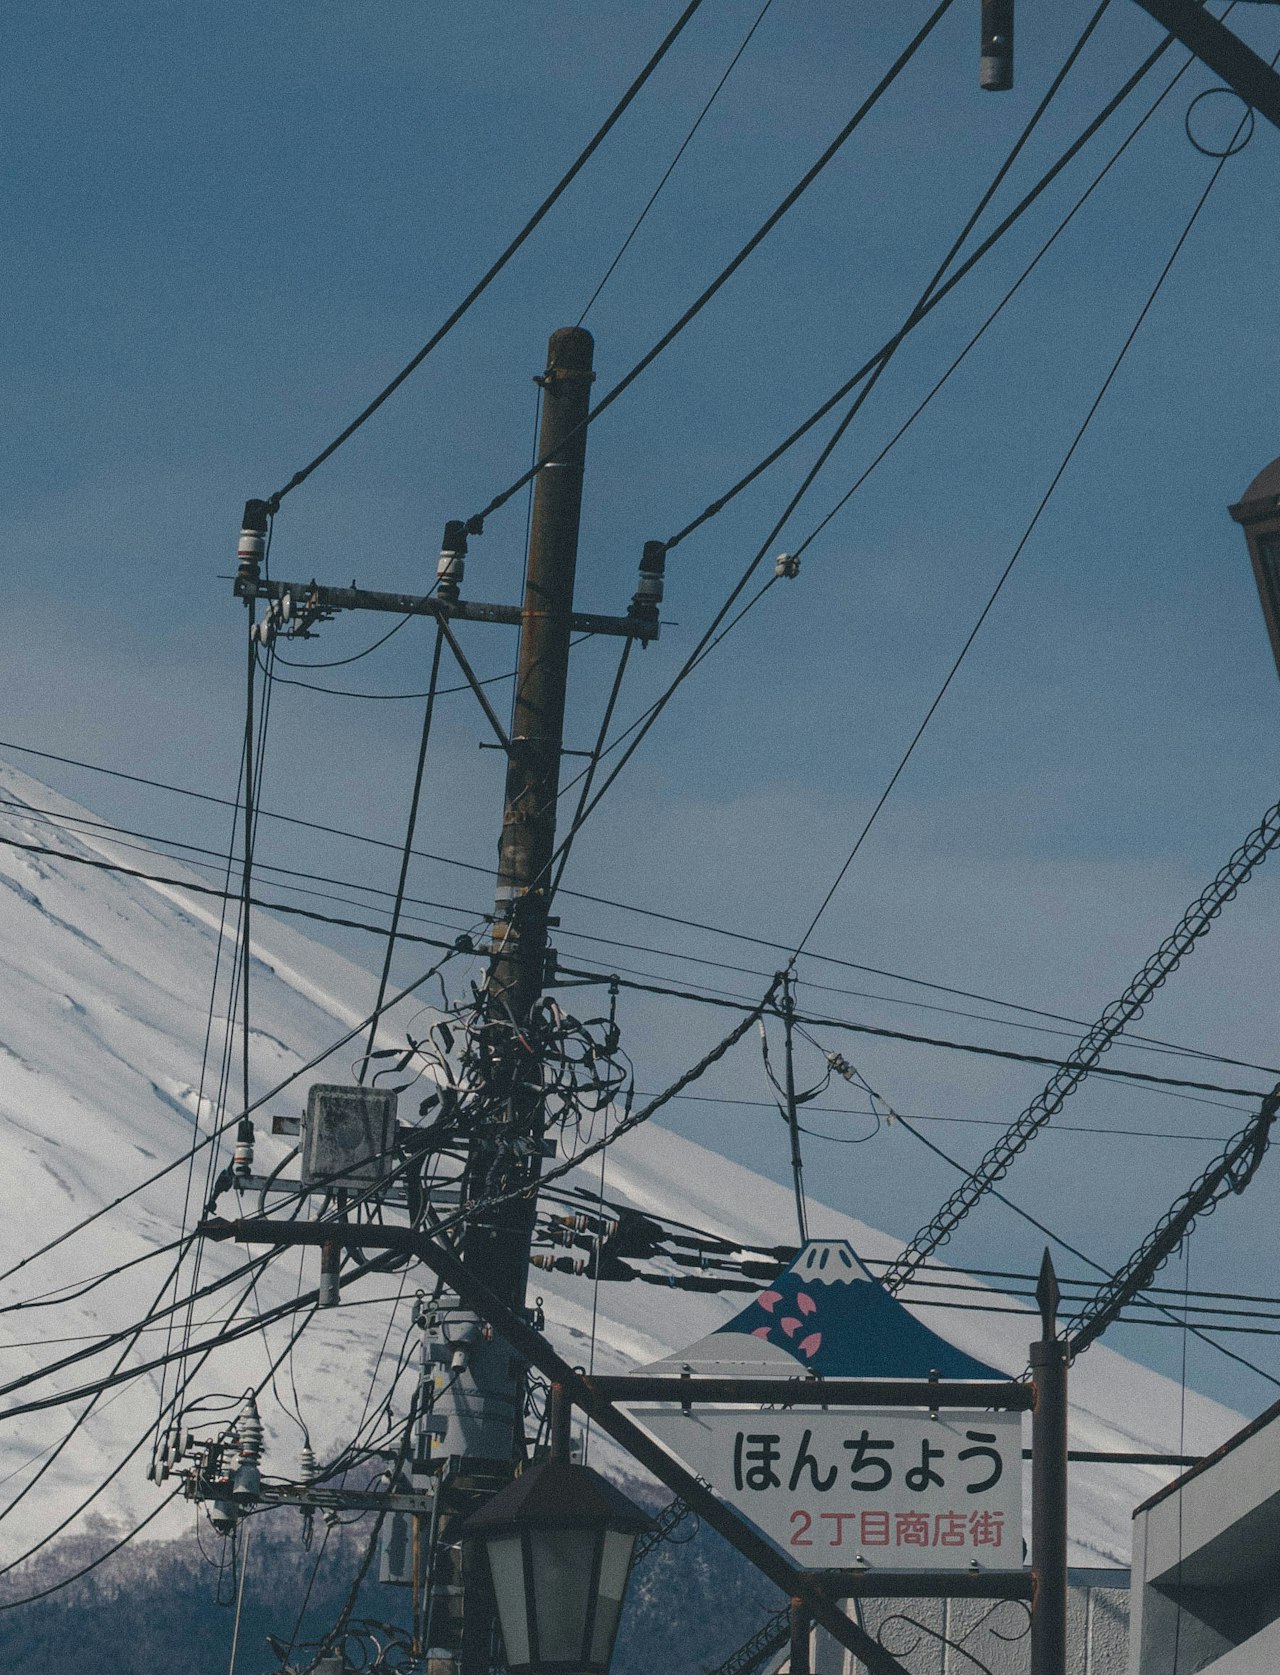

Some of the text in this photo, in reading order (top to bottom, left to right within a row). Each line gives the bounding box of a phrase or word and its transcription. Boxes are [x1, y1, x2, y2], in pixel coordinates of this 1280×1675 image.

[731, 1429, 1005, 1494] ほんちょう
[788, 1509, 1005, 1550] 2丁目商店街
